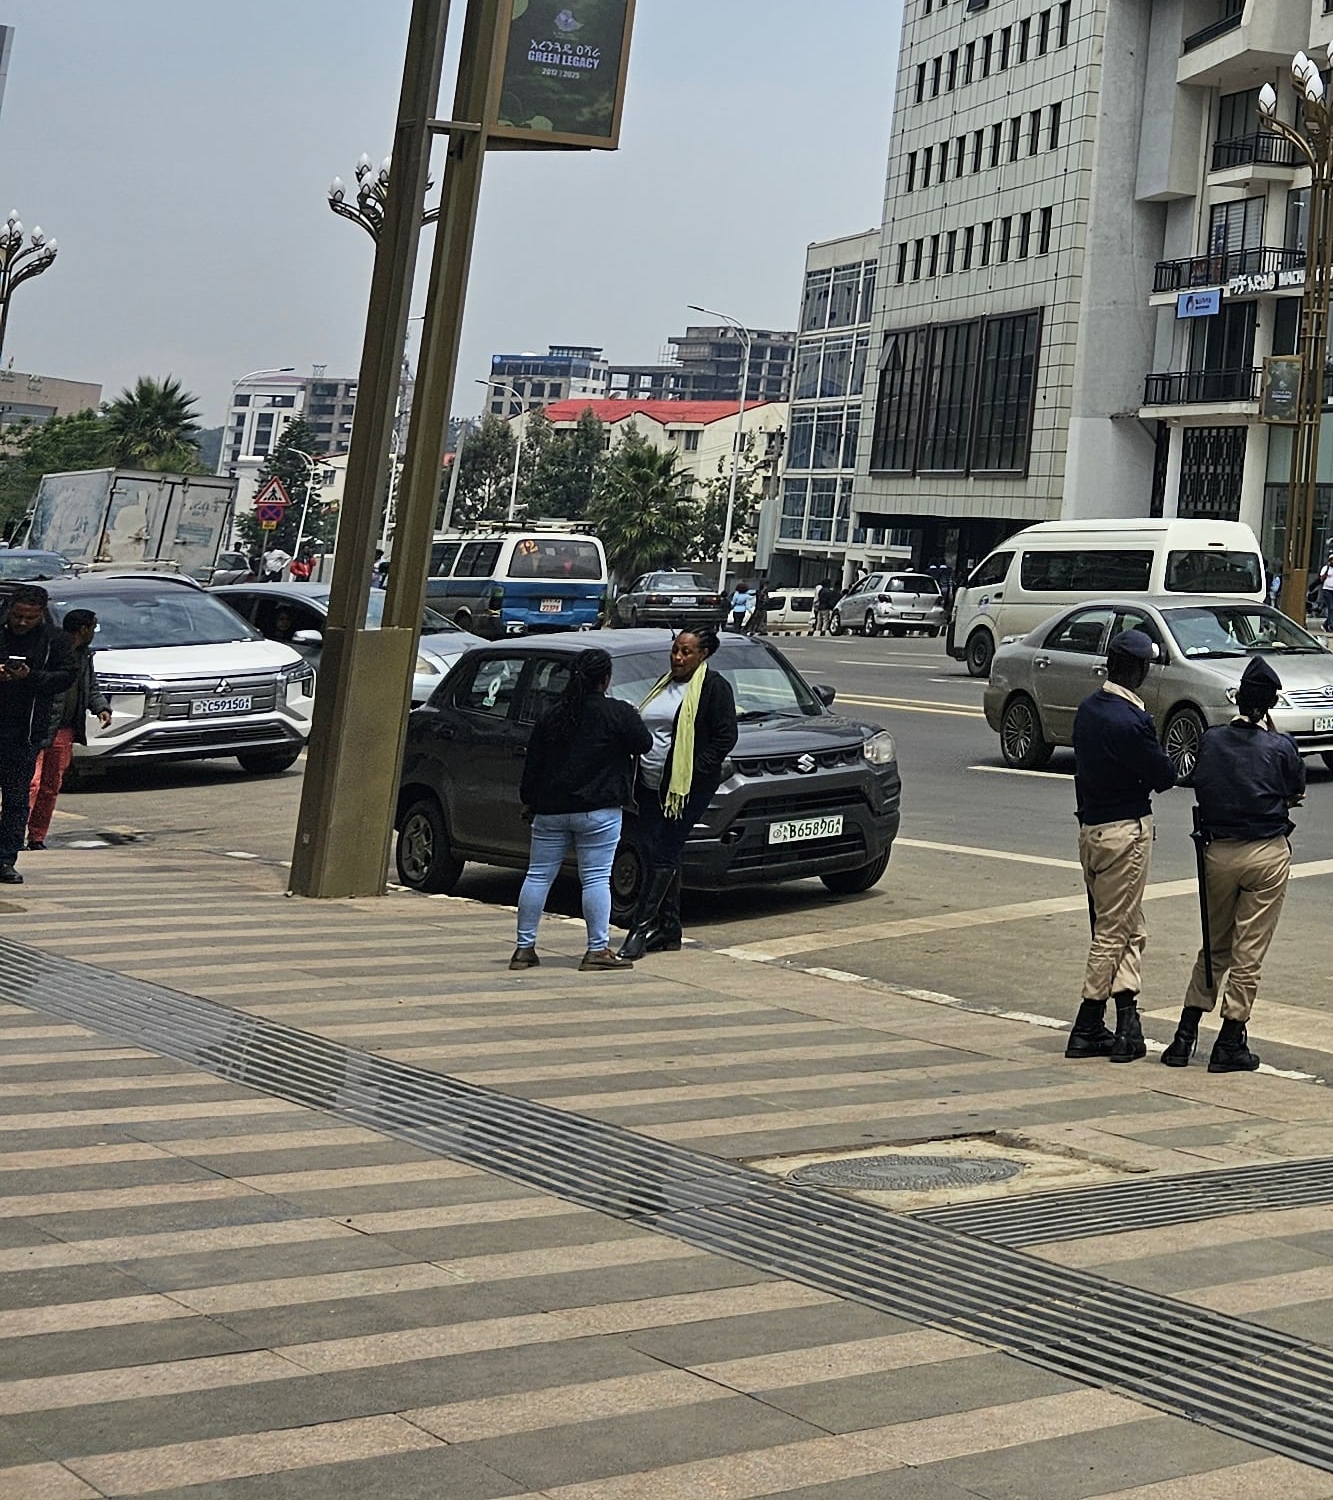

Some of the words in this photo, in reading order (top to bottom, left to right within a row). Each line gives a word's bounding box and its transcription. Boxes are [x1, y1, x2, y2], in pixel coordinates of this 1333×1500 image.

[527, 50, 560, 65] GREEN
[561, 54, 600, 70] LEGACY
[518, 539, 539, 557] 12
